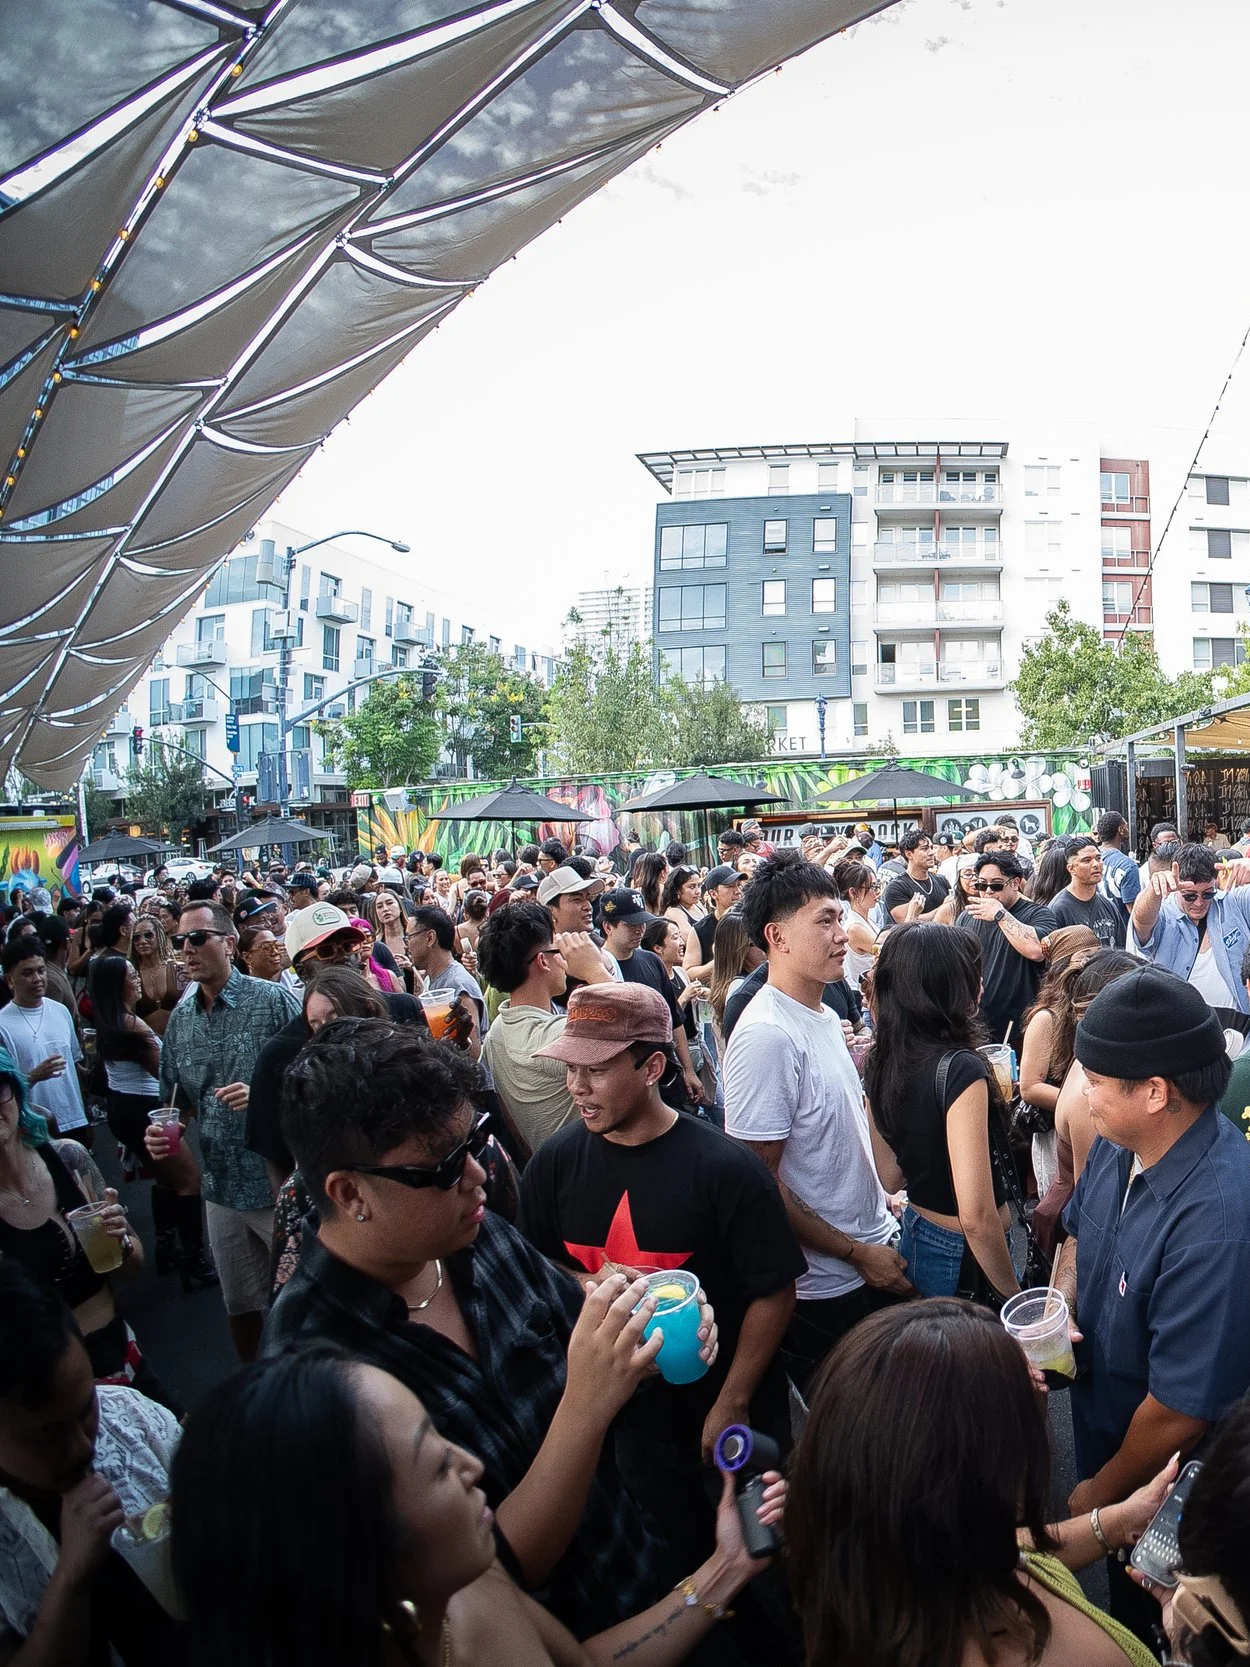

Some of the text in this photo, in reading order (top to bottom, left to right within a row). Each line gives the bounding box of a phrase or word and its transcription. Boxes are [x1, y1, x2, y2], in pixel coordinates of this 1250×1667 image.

[768, 736, 807, 751] RKET
[759, 828, 794, 846] OUR
[878, 822, 915, 841] OCK
